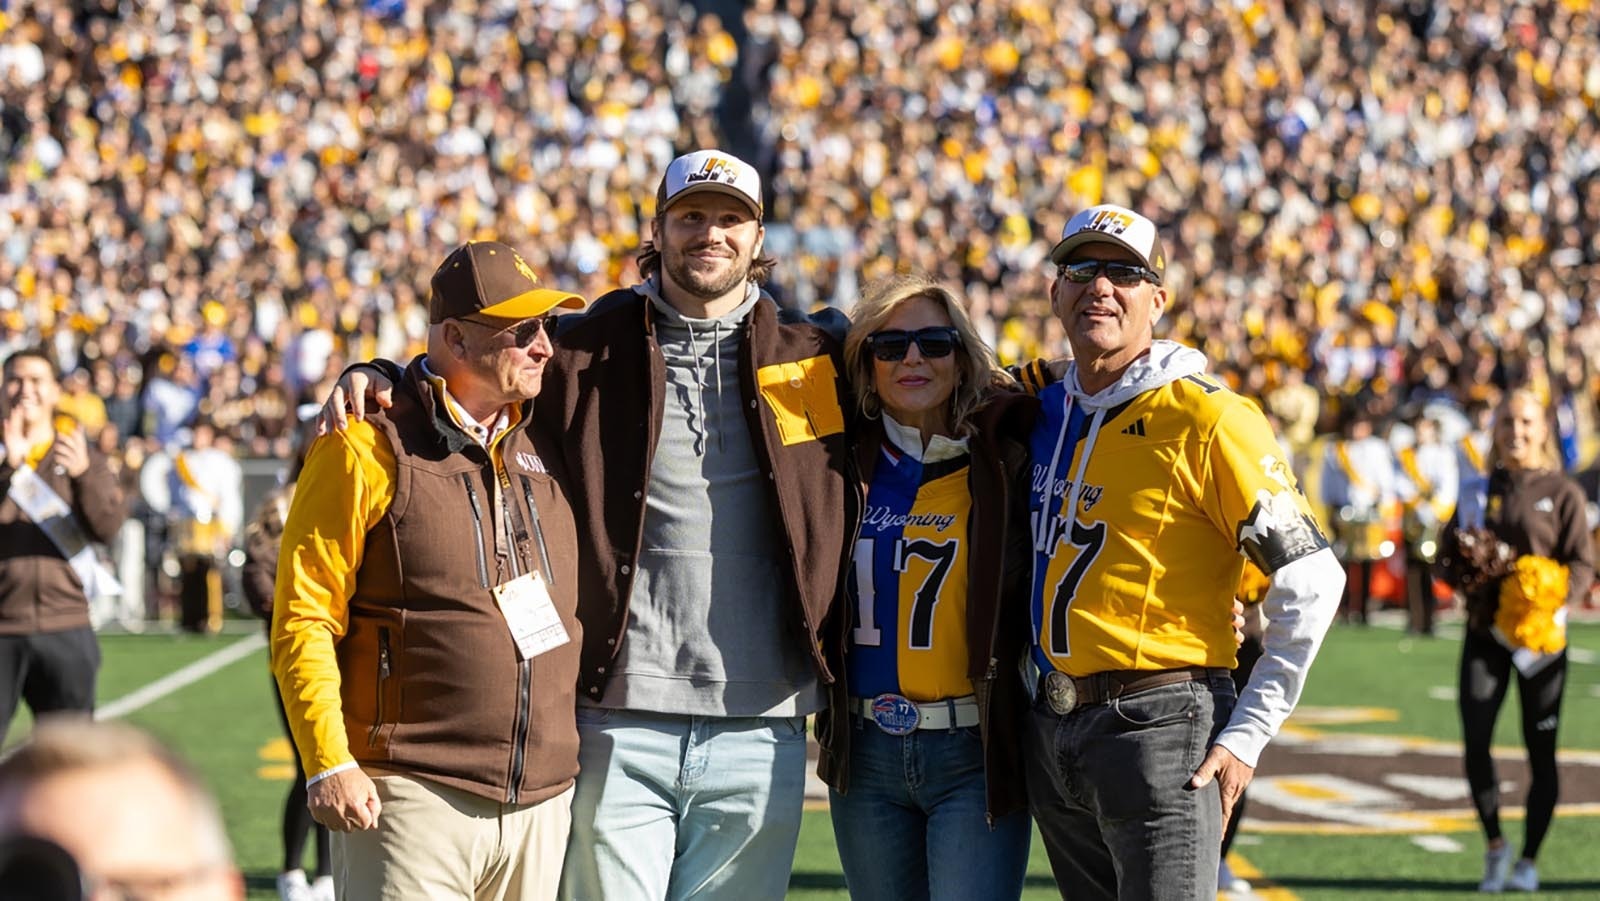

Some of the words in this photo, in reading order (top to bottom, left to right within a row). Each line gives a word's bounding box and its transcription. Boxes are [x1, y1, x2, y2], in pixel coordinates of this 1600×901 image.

[1181, 371, 1221, 395] 1
[1032, 463, 1105, 511] Wyomng
[862, 505, 958, 532] Wyoming
[852, 537, 960, 650] 17
